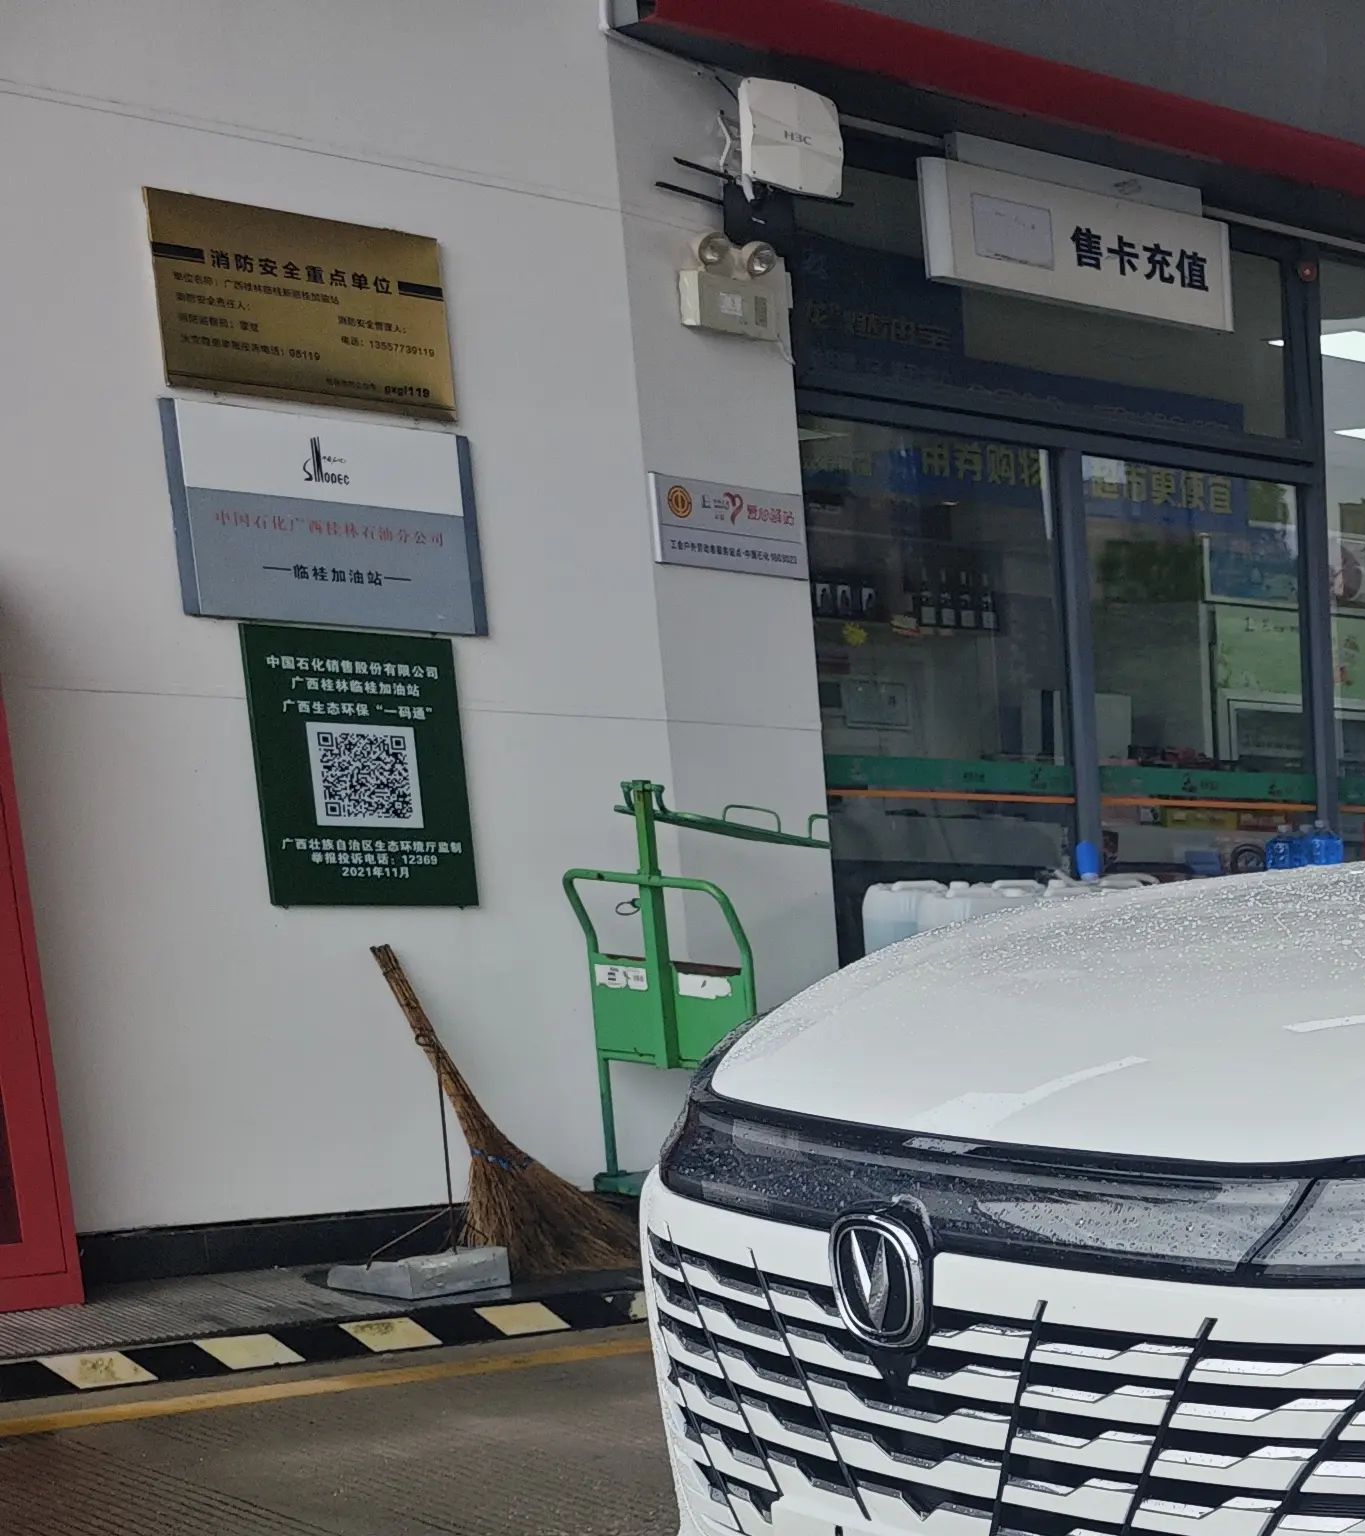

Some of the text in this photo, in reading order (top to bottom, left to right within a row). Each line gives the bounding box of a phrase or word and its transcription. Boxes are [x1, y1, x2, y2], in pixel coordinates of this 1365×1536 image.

[784, 130, 813, 146] H3C
[1070, 225, 1209, 292] 售卡充值
[210, 249, 392, 295] 消防安全重点单位
[214, 509, 444, 548] 中国石化广西桂林石油分公司
[265, 654, 440, 680] 中国石化销售股份有限公司
[291, 676, 421, 697] 广西桂林临桂加油站
[281, 838, 463, 854] 广西壮族自治区生态环境厅监制
[341, 866, 411, 879] 2021年11月
